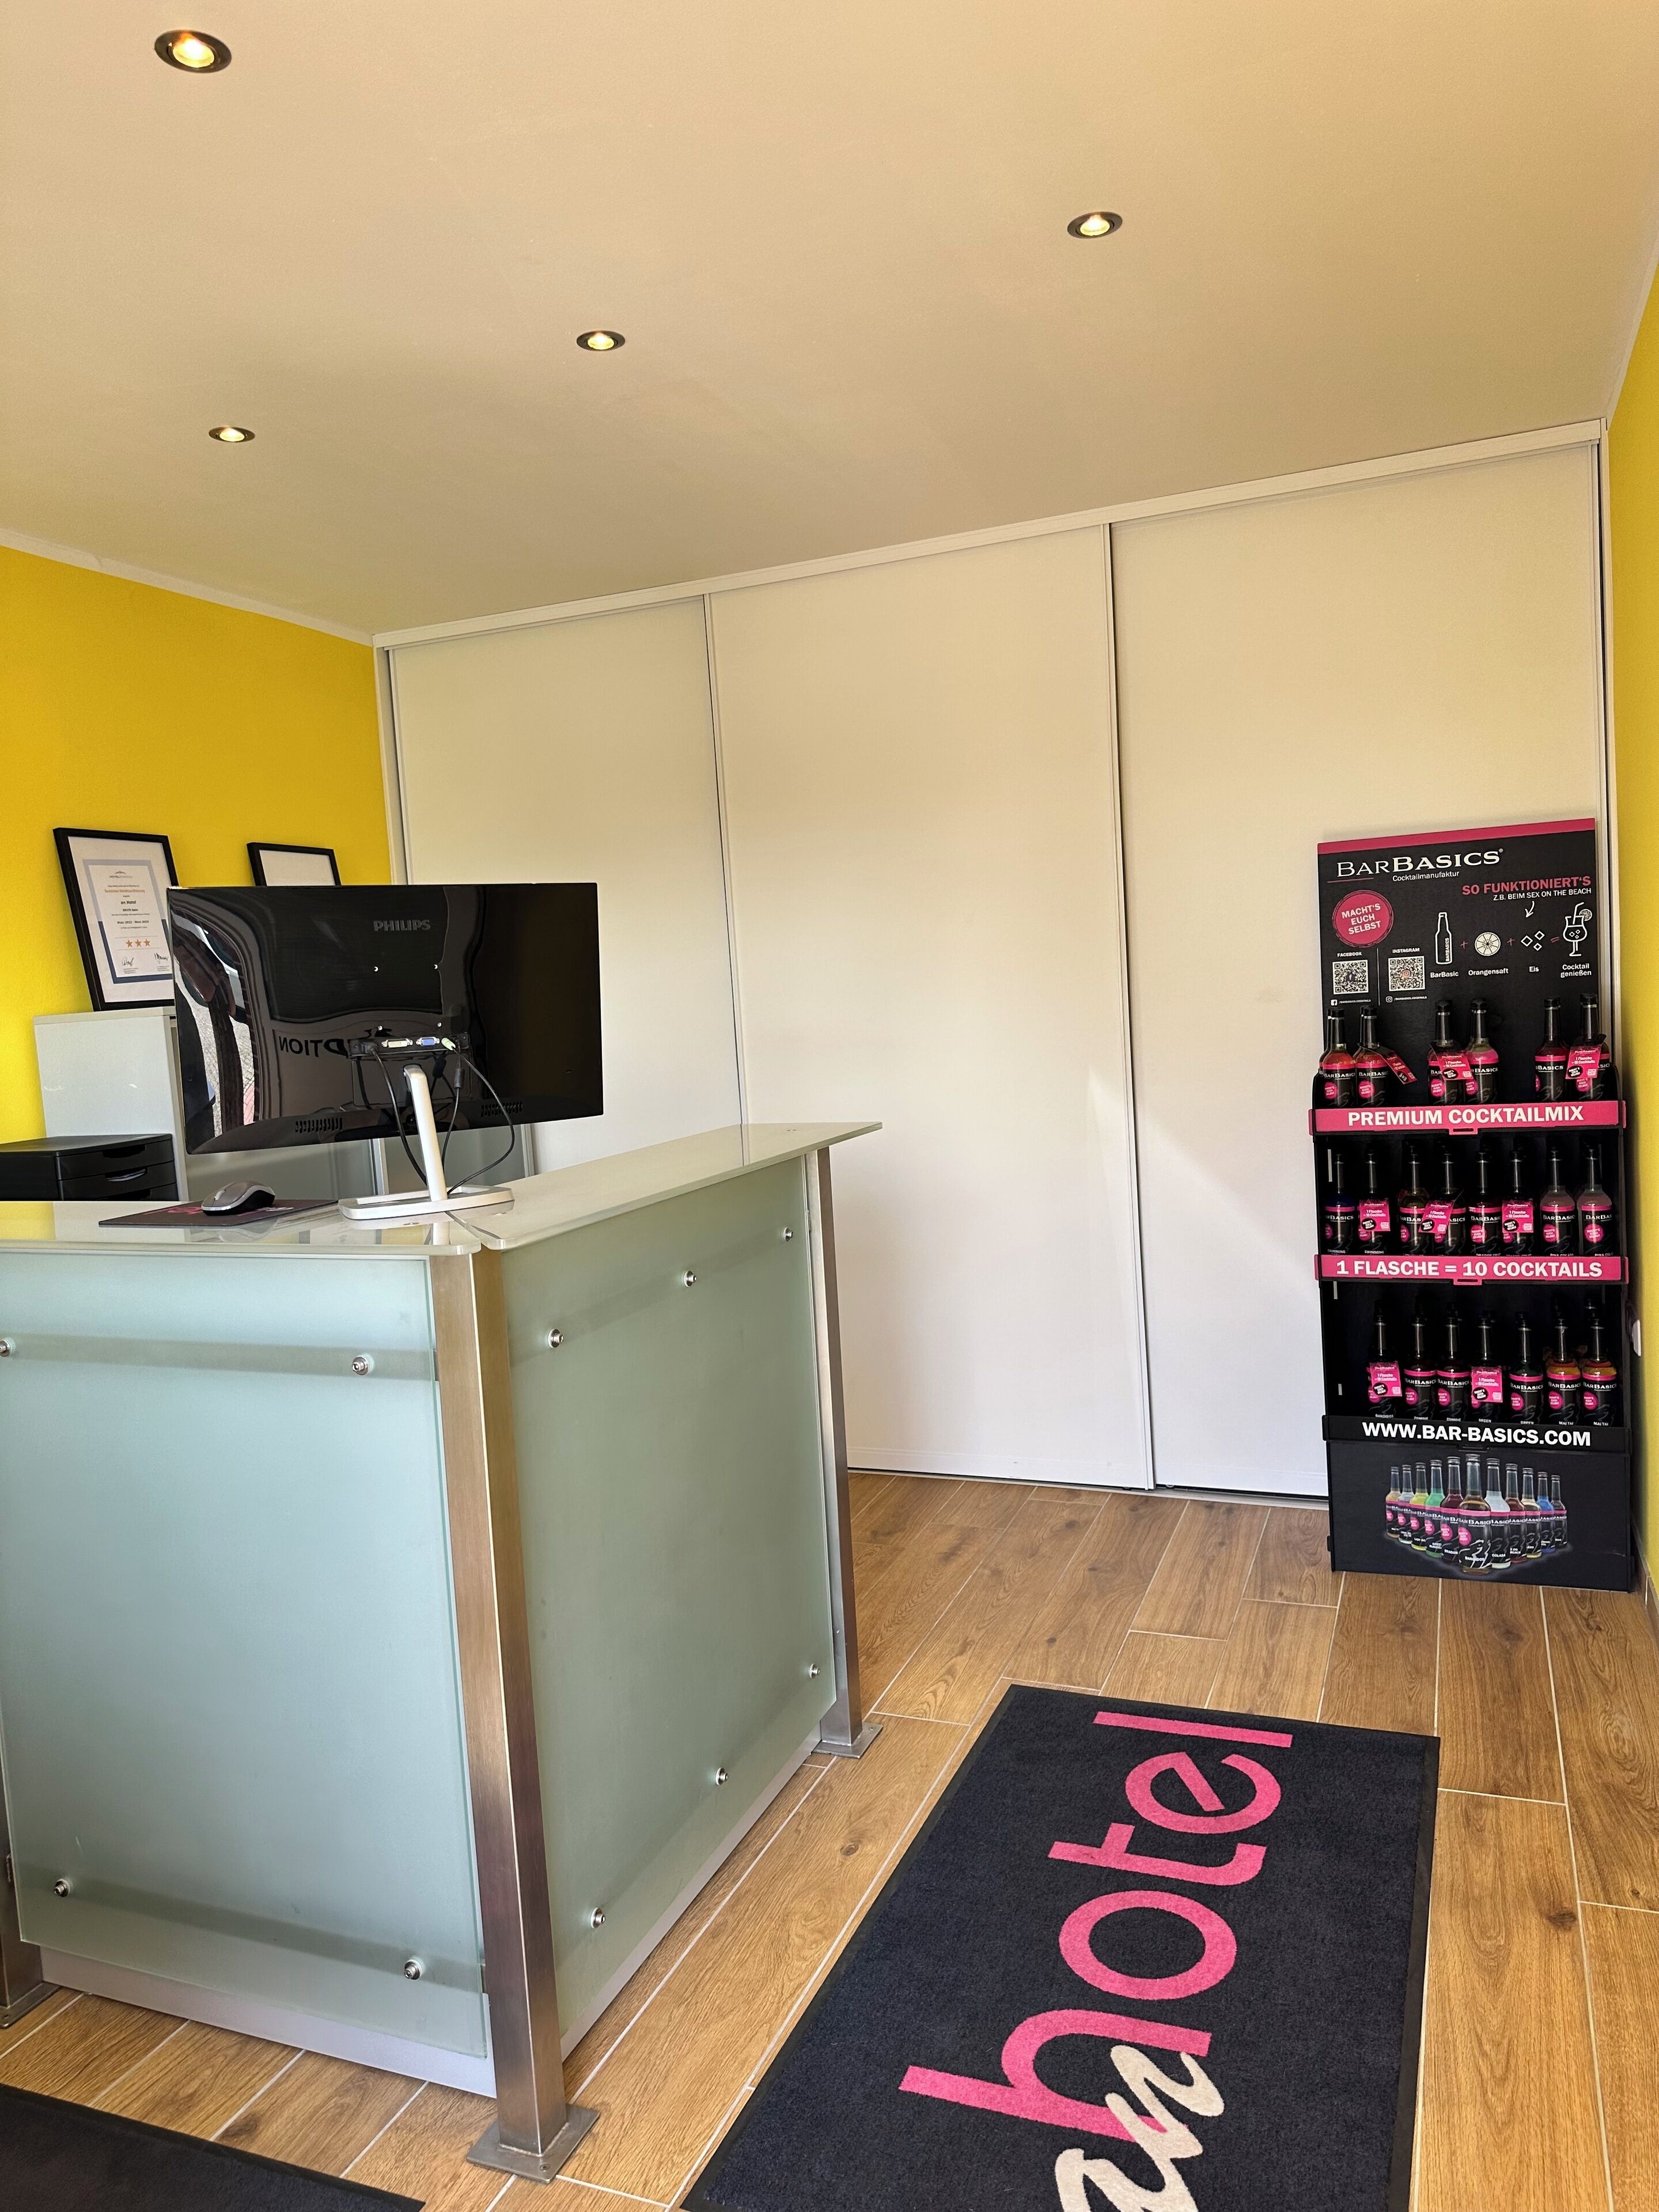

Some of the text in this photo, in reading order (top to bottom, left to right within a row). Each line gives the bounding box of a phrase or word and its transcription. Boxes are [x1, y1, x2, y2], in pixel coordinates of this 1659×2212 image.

[1392, 870, 1460, 882] Cocktailmanufaktur
[1462, 876, 1592, 895] SO FUNKTIONIERT'S
[1341, 903, 1381, 919] MACHT'S
[373, 920, 431, 931] PHILIPS
[1350, 914, 1375, 926] EUCH
[1348, 921, 1381, 935] SELBST
[1468, 968, 1509, 976] Orangensaft
[1560, 970, 1592, 978] genießen
[1348, 1105, 1584, 1126] PREMIUM COCKTAILMIX
[1336, 1260, 1349, 1275] 1
[1354, 1260, 1440, 1276] FLASCHE
[1463, 1261, 1487, 1277] 10
[1493, 1262, 1603, 1277] COCKTAILS
[1362, 1422, 1591, 1446] WWW.BAR-BASICS.COM
[898, 1710, 1293, 2144] hotel
